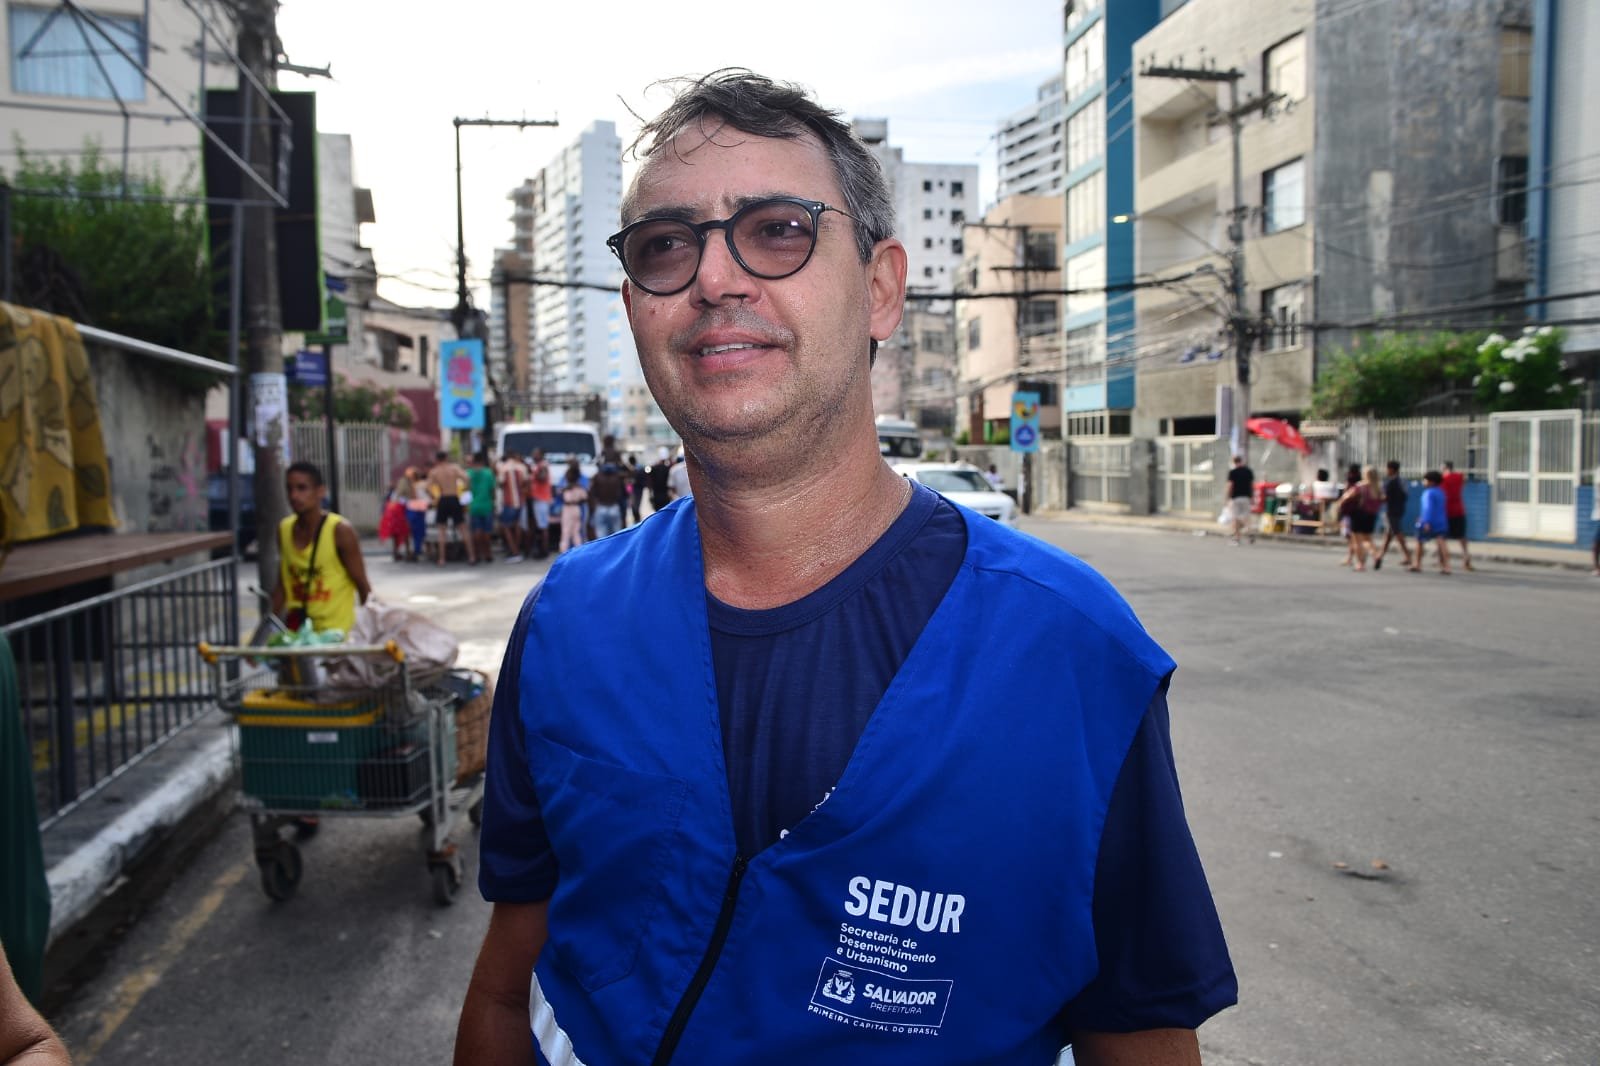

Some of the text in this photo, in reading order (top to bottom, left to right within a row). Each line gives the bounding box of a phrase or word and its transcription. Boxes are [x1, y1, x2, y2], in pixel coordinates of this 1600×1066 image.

[844, 876, 966, 933] SEDUR
[839, 934, 936, 963] Desenvolvimento
[840, 922, 918, 949] Secretaria de
[836, 946, 908, 973] e Urbanismo
[862, 983, 937, 1005] SALVADOR
[807, 1005, 939, 1036] PRIMEIRA CAPITAL DO BRASIL
[870, 1002, 922, 1015] PREFEITURA
